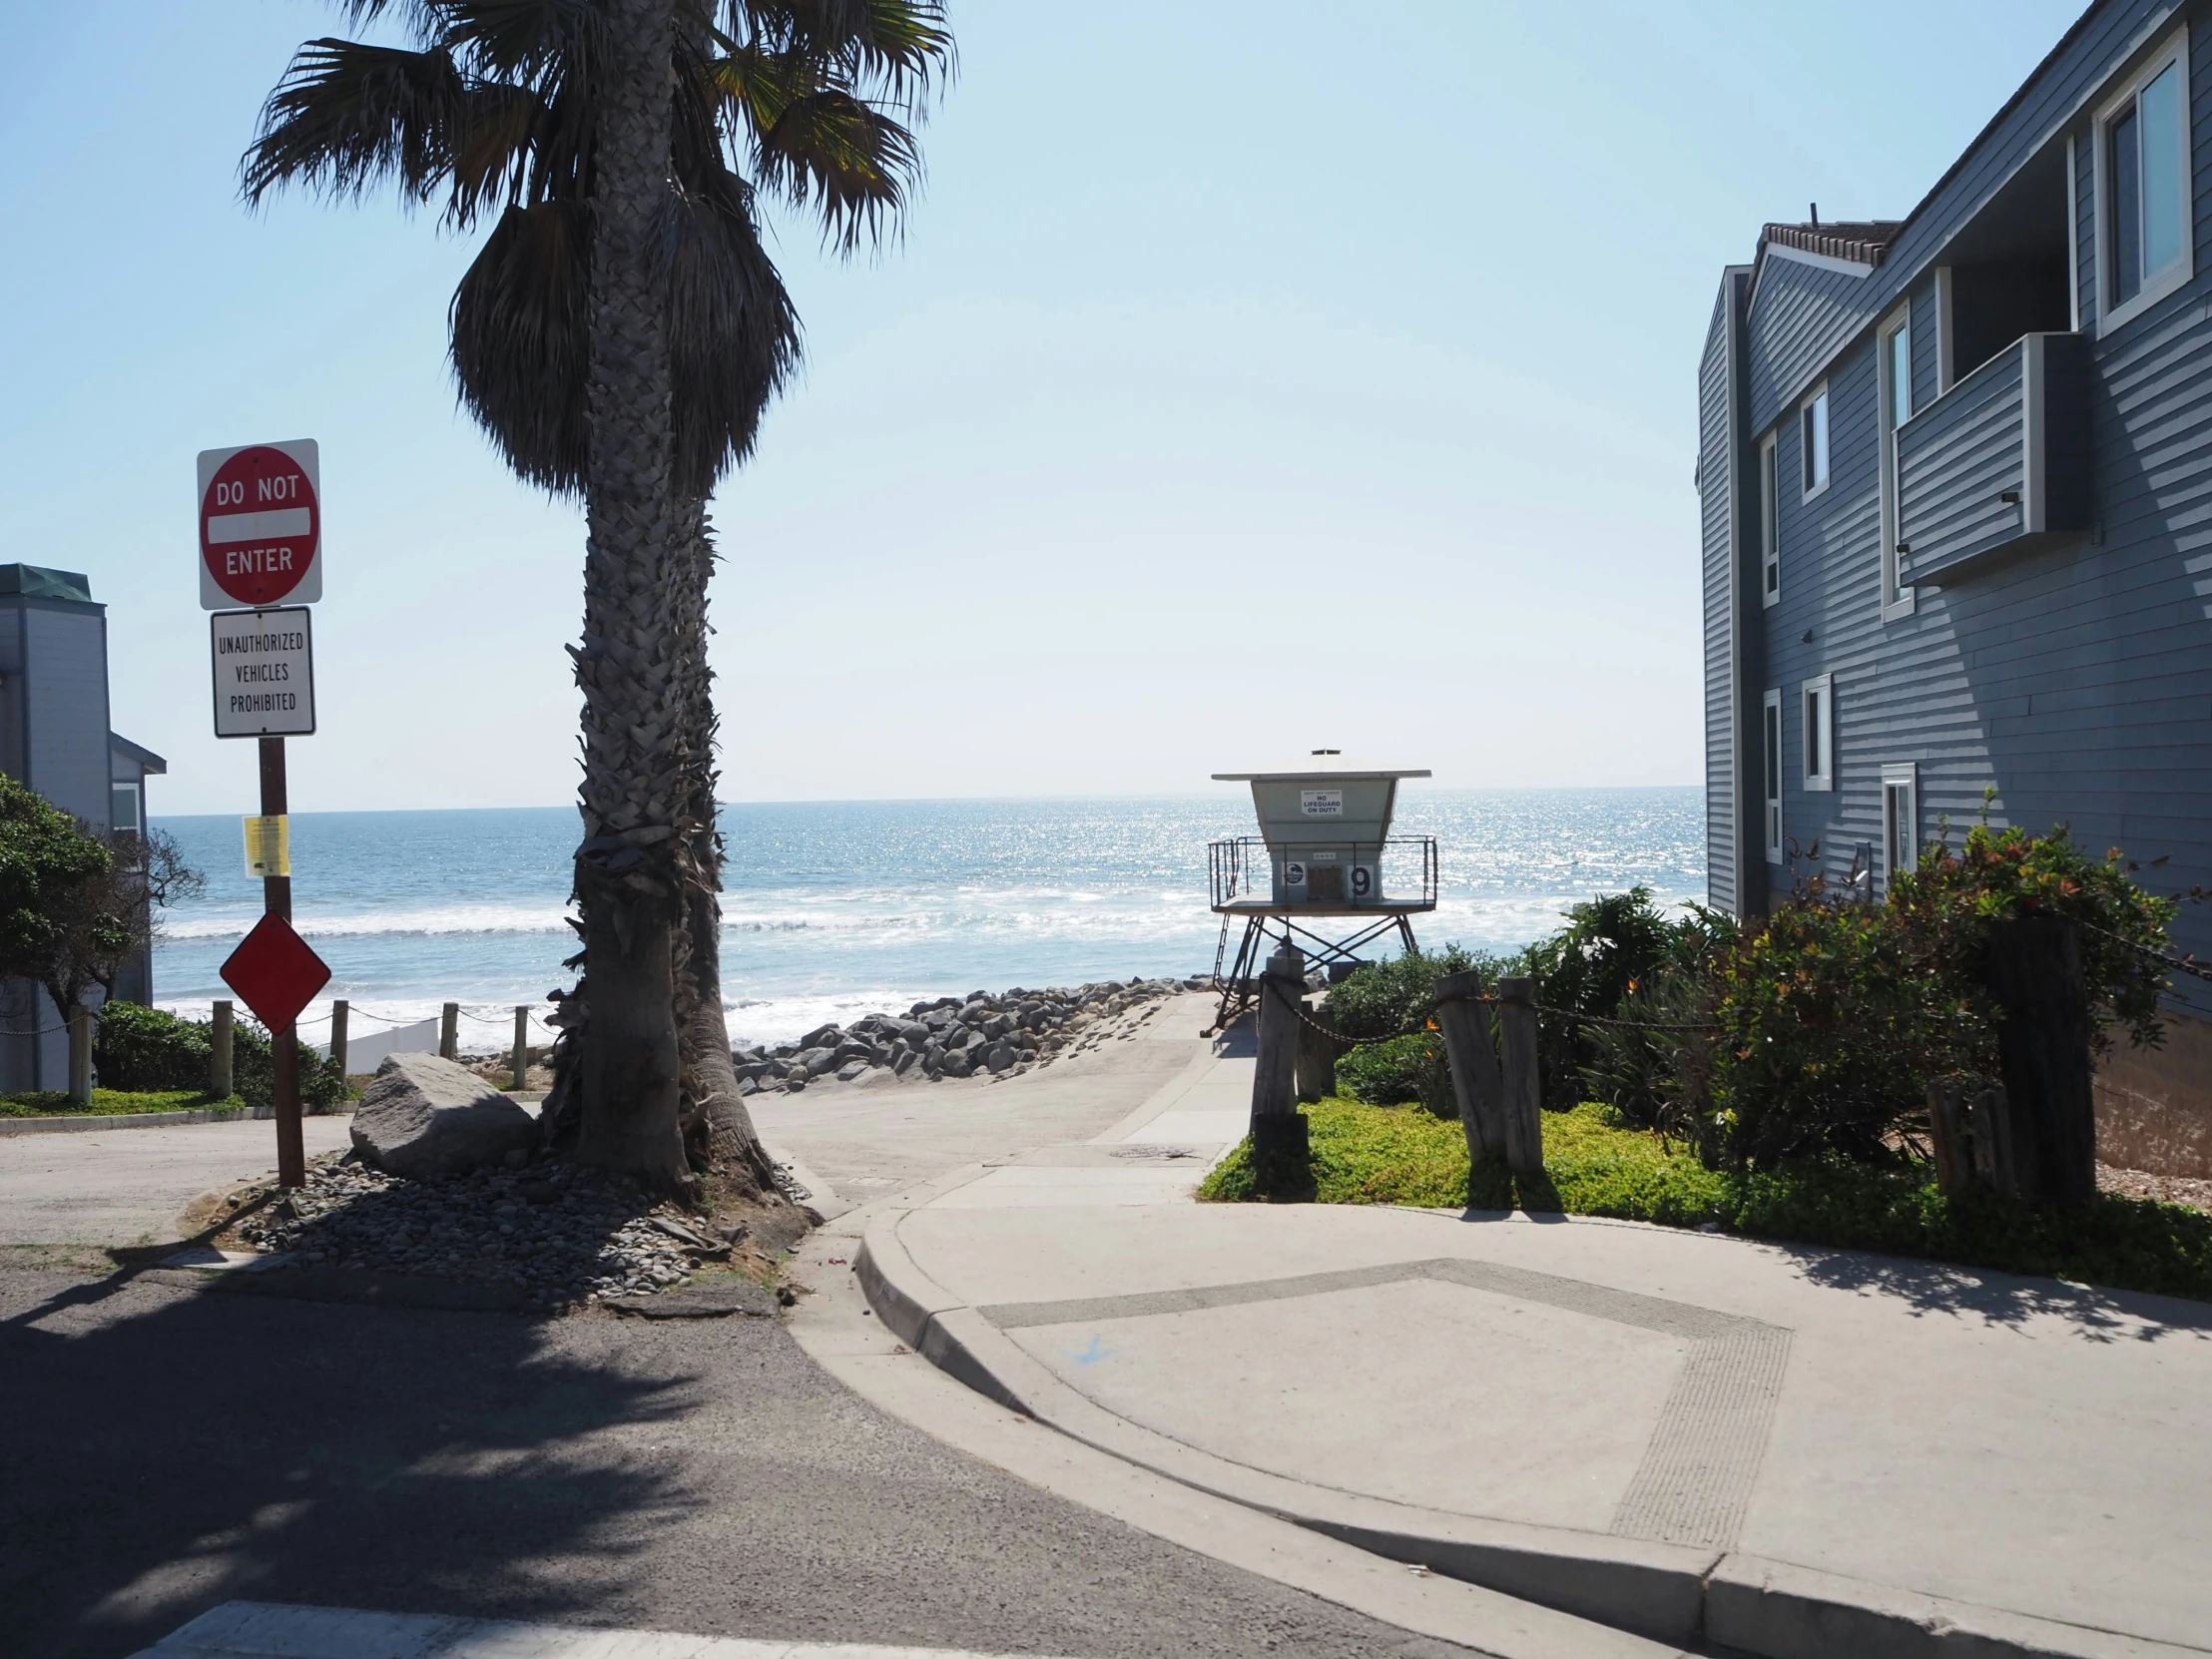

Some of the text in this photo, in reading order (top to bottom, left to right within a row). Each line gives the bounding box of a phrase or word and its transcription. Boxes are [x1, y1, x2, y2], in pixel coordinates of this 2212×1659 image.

[217, 474, 299, 506] DO NOT
[226, 547, 292, 575] ENTER
[219, 632, 303, 655] UNAUTHORIZED
[236, 663, 288, 683] VEHICLES
[231, 693, 296, 713] PROHIBITED
[1351, 866, 1371, 896] 9
